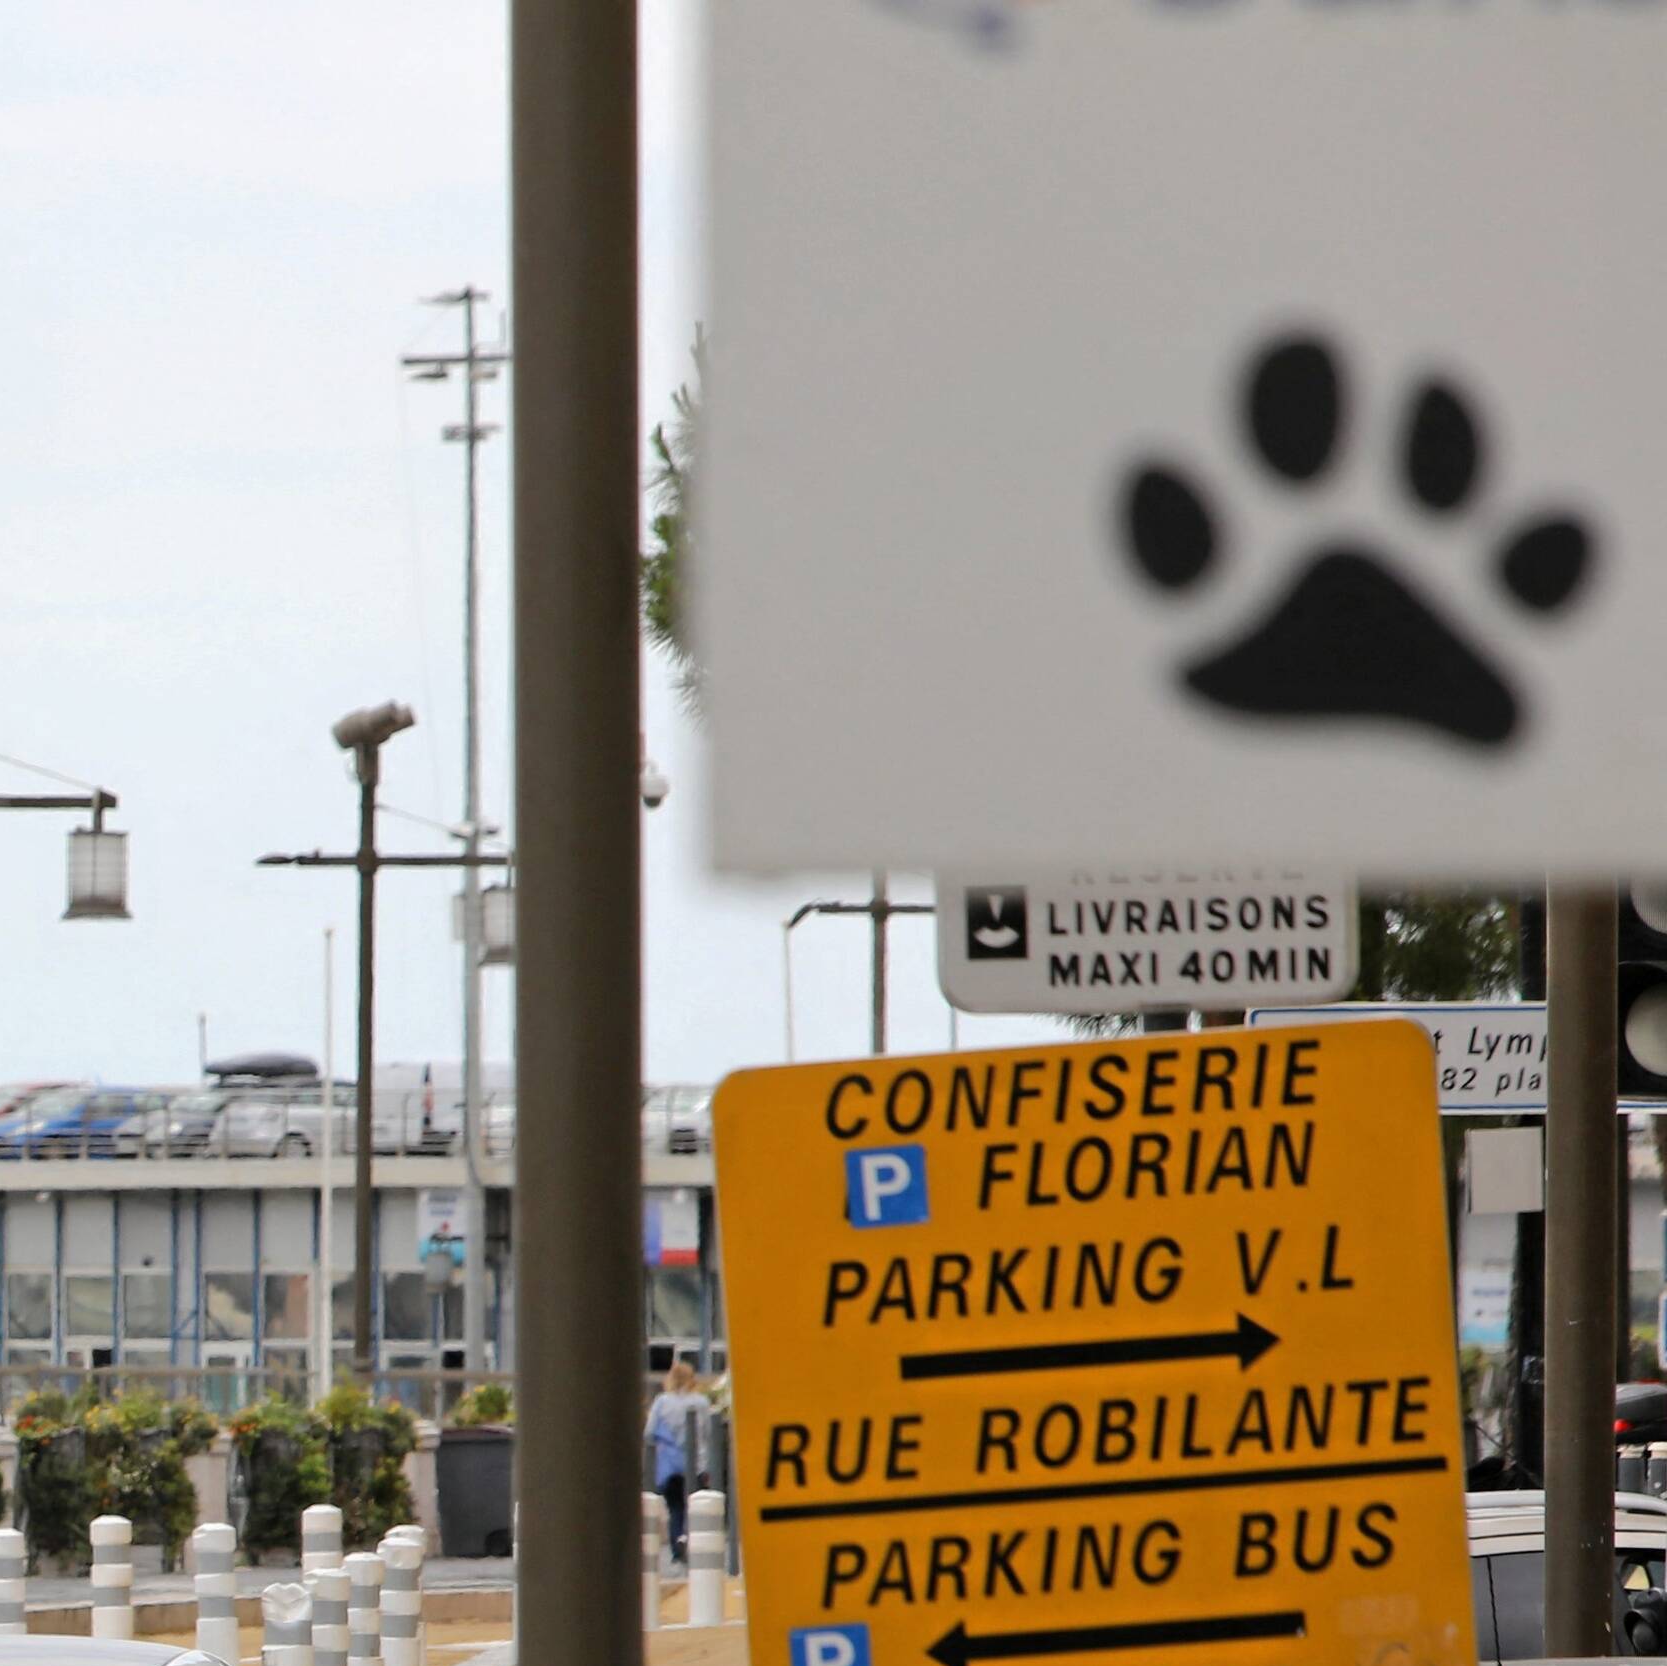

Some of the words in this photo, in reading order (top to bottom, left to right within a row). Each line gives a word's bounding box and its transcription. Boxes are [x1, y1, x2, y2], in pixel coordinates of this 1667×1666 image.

[1049, 893, 1329, 936] LIVRAISONS
[1049, 951, 1158, 987] MAXI
[825, 1040, 1322, 1141] CONFISERIE
[1495, 1067, 1542, 1097] pla
[859, 1153, 911, 1222] P
[978, 1121, 1316, 1210] FLORIAN
[822, 1237, 1185, 1327] PARKING
[764, 1414, 924, 1490] RUE
[975, 1376, 1431, 1476] ROBILANTE
[821, 1521, 1183, 1611] PARKING
[1233, 1502, 1399, 1578] BUS
